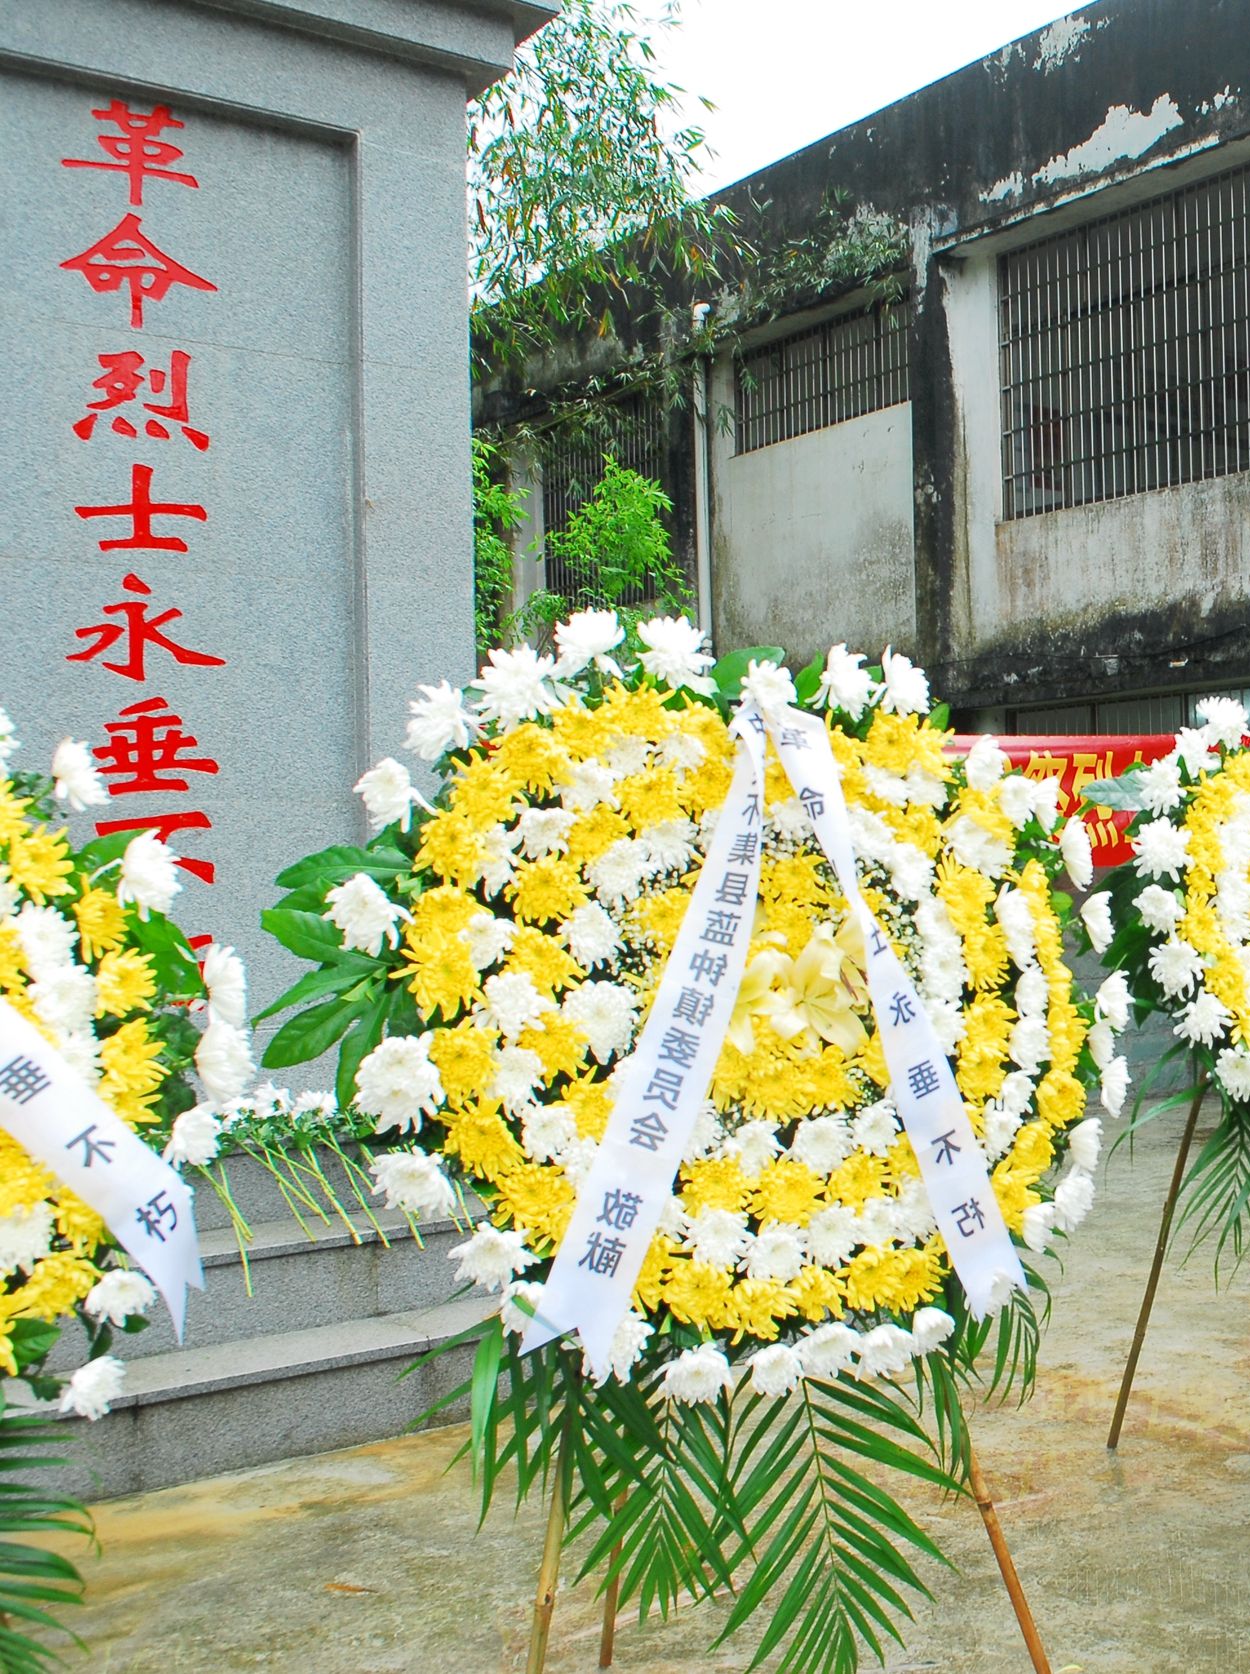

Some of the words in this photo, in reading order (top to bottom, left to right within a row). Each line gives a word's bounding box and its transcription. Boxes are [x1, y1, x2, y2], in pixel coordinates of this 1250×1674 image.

[59, 98, 227, 1011] 革命烈士永垂不
[0, 1055, 178, 1243] 垂不朽
